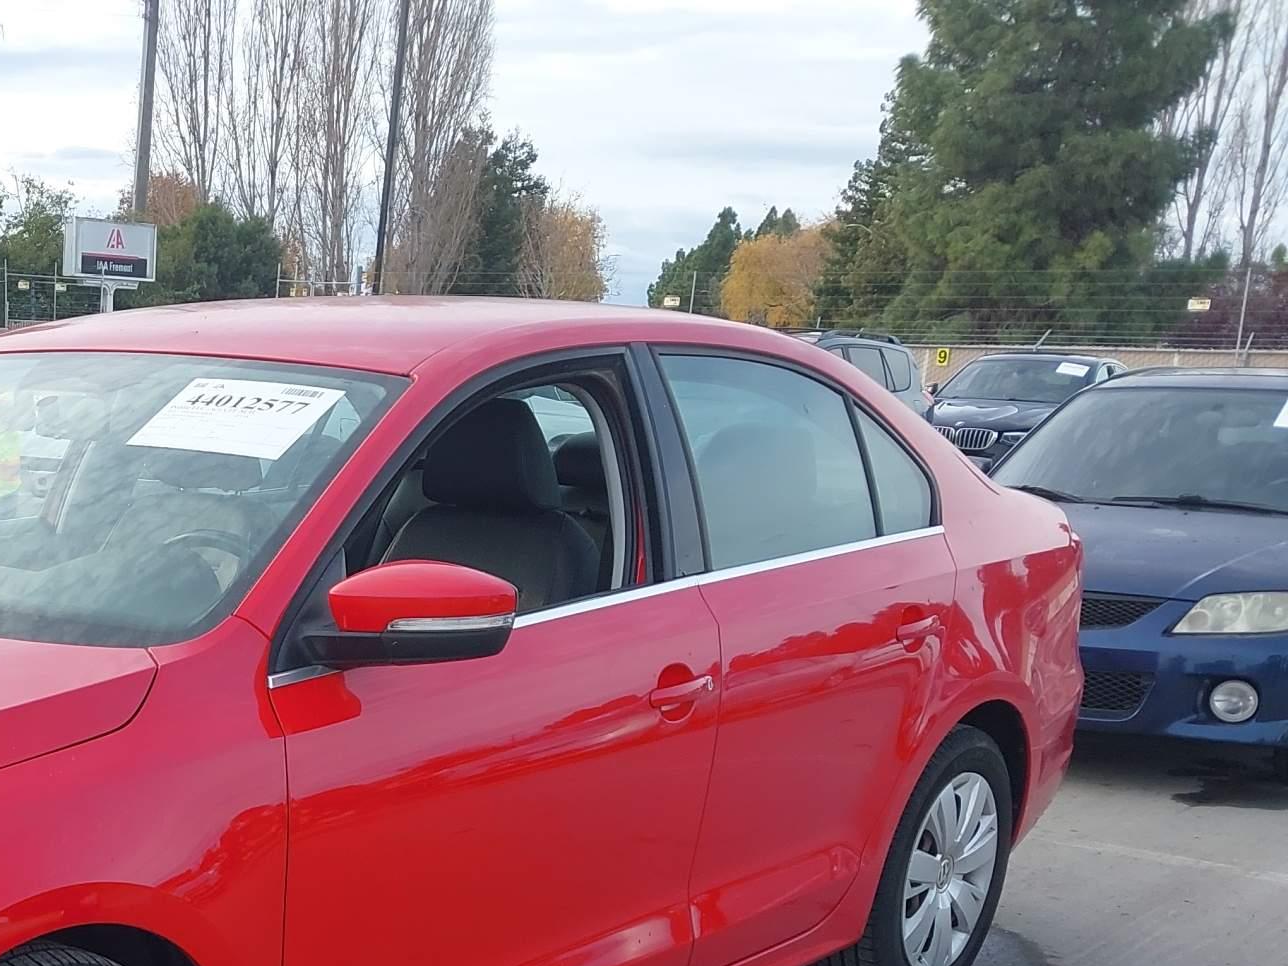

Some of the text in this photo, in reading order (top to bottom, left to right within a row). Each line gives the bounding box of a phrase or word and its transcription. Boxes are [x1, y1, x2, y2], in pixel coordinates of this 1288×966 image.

[109, 261, 133, 273] Fremont
[937, 349, 948, 364] 9
[185, 393, 312, 415] 44012577
